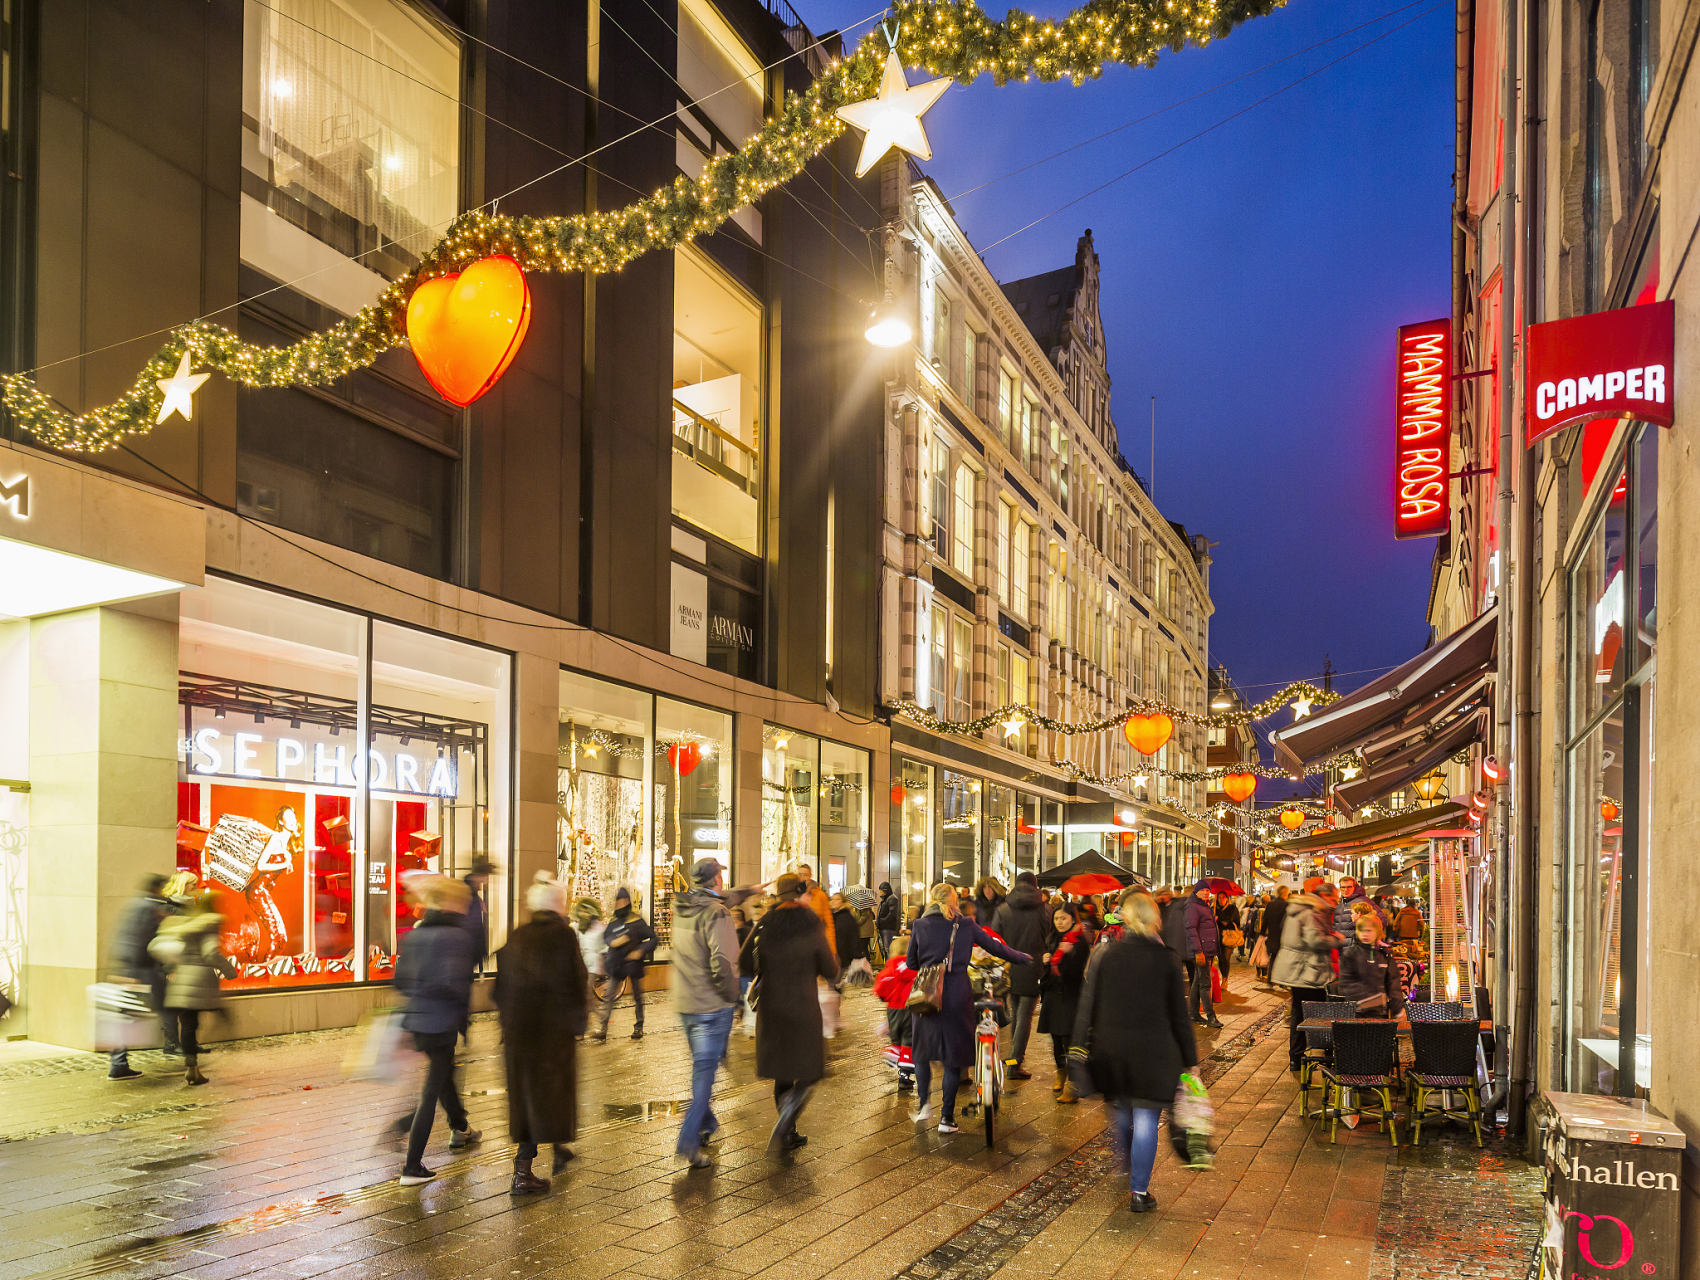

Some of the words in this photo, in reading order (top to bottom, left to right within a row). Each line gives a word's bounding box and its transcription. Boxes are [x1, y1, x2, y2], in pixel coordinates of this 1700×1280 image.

[1402, 333, 1444, 440] MAMMA
[1536, 364, 1665, 420] CAMPER
[1400, 448, 1444, 519] ROSA
[678, 604, 702, 621] ARMANI
[680, 615, 700, 630] JEANS
[710, 614, 753, 647] ARMANI
[193, 727, 457, 797] SEPHORA
